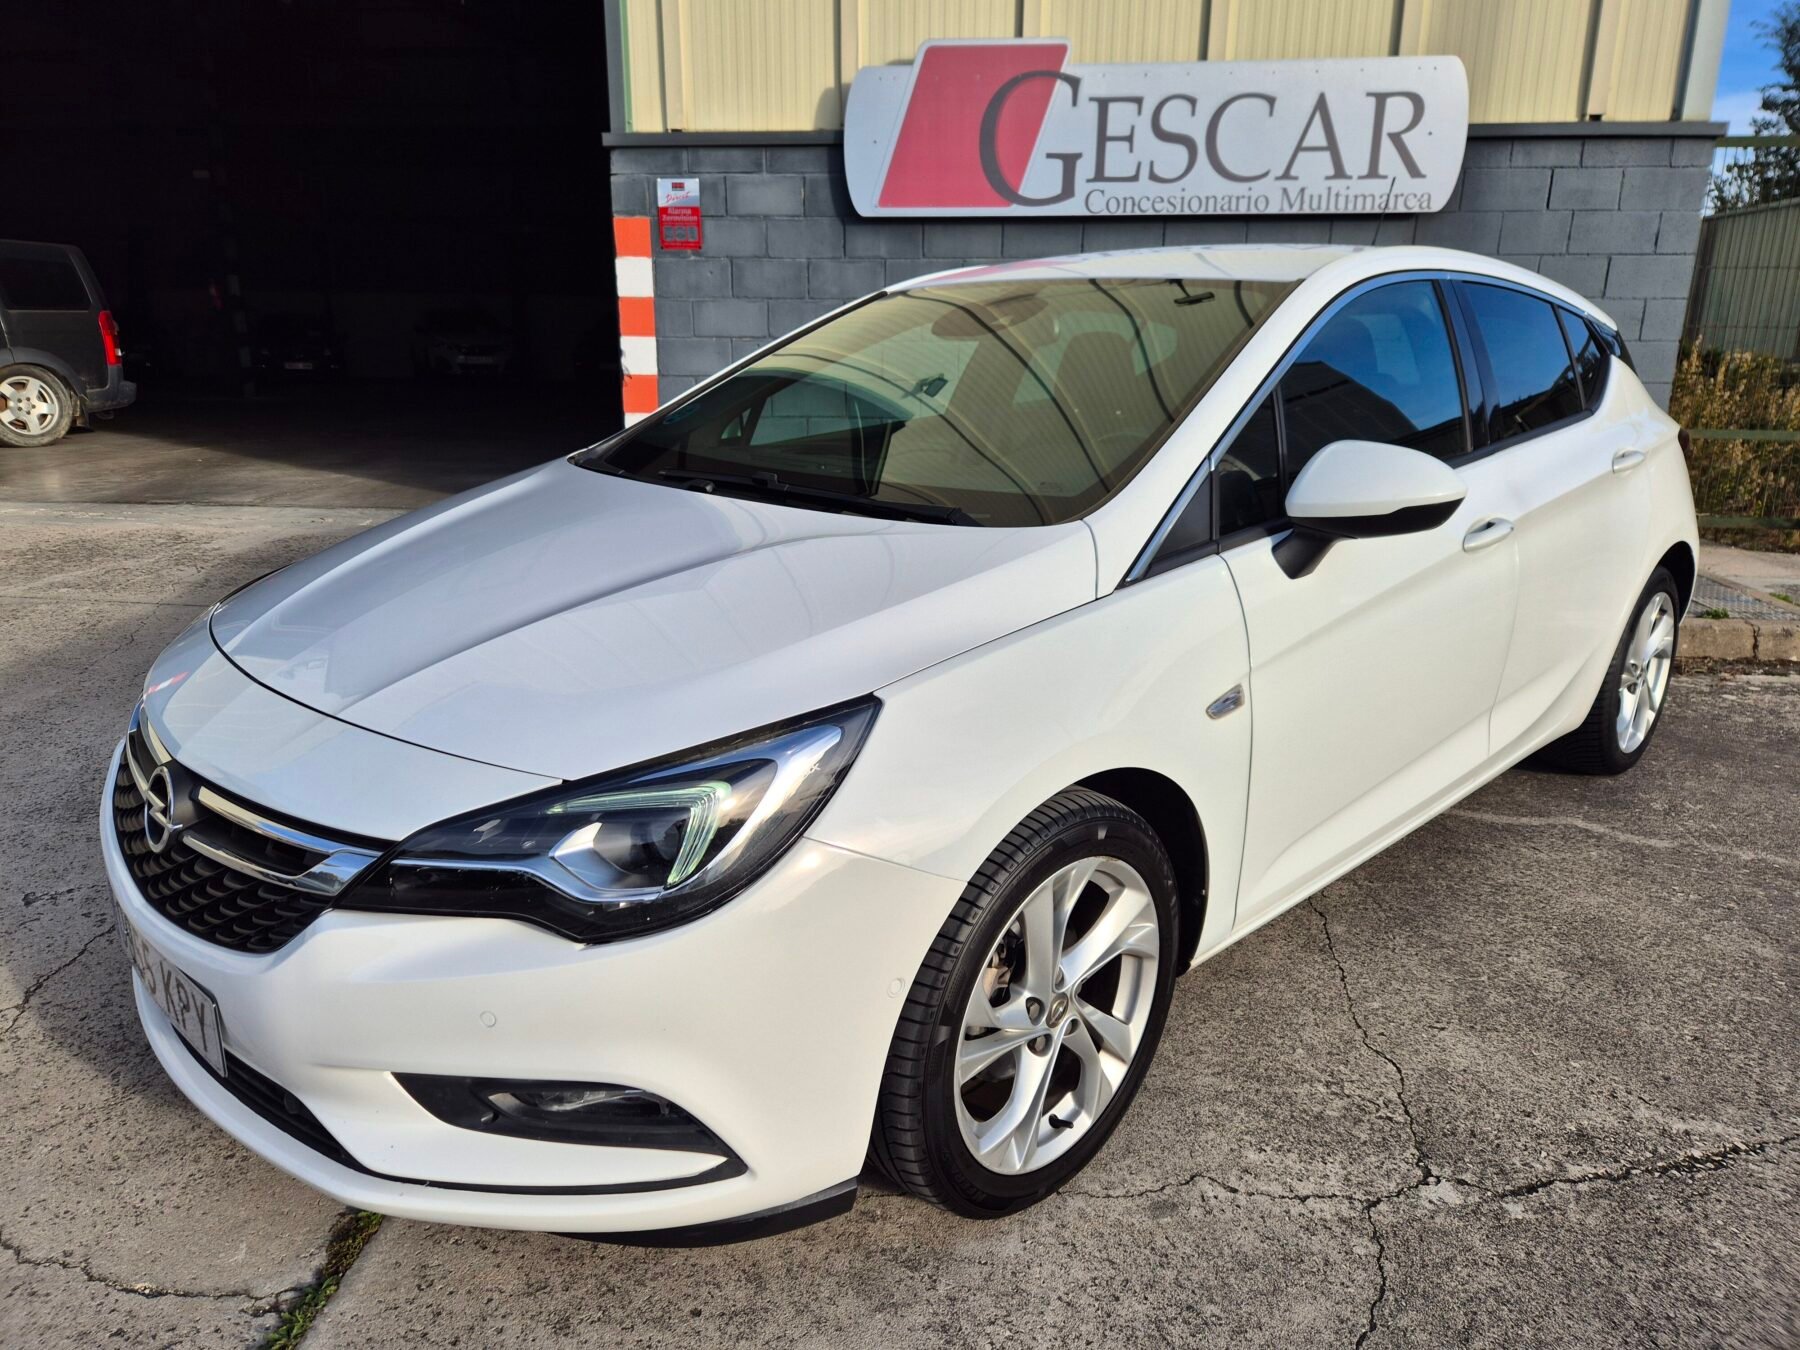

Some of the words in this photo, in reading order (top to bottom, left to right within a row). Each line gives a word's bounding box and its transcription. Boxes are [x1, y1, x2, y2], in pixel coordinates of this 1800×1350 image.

[979, 70, 1427, 207] GESCAR
[1084, 188, 1269, 215] Concesionario
[1280, 185, 1432, 213] Multimarca
[159, 960, 208, 1053] KPY
